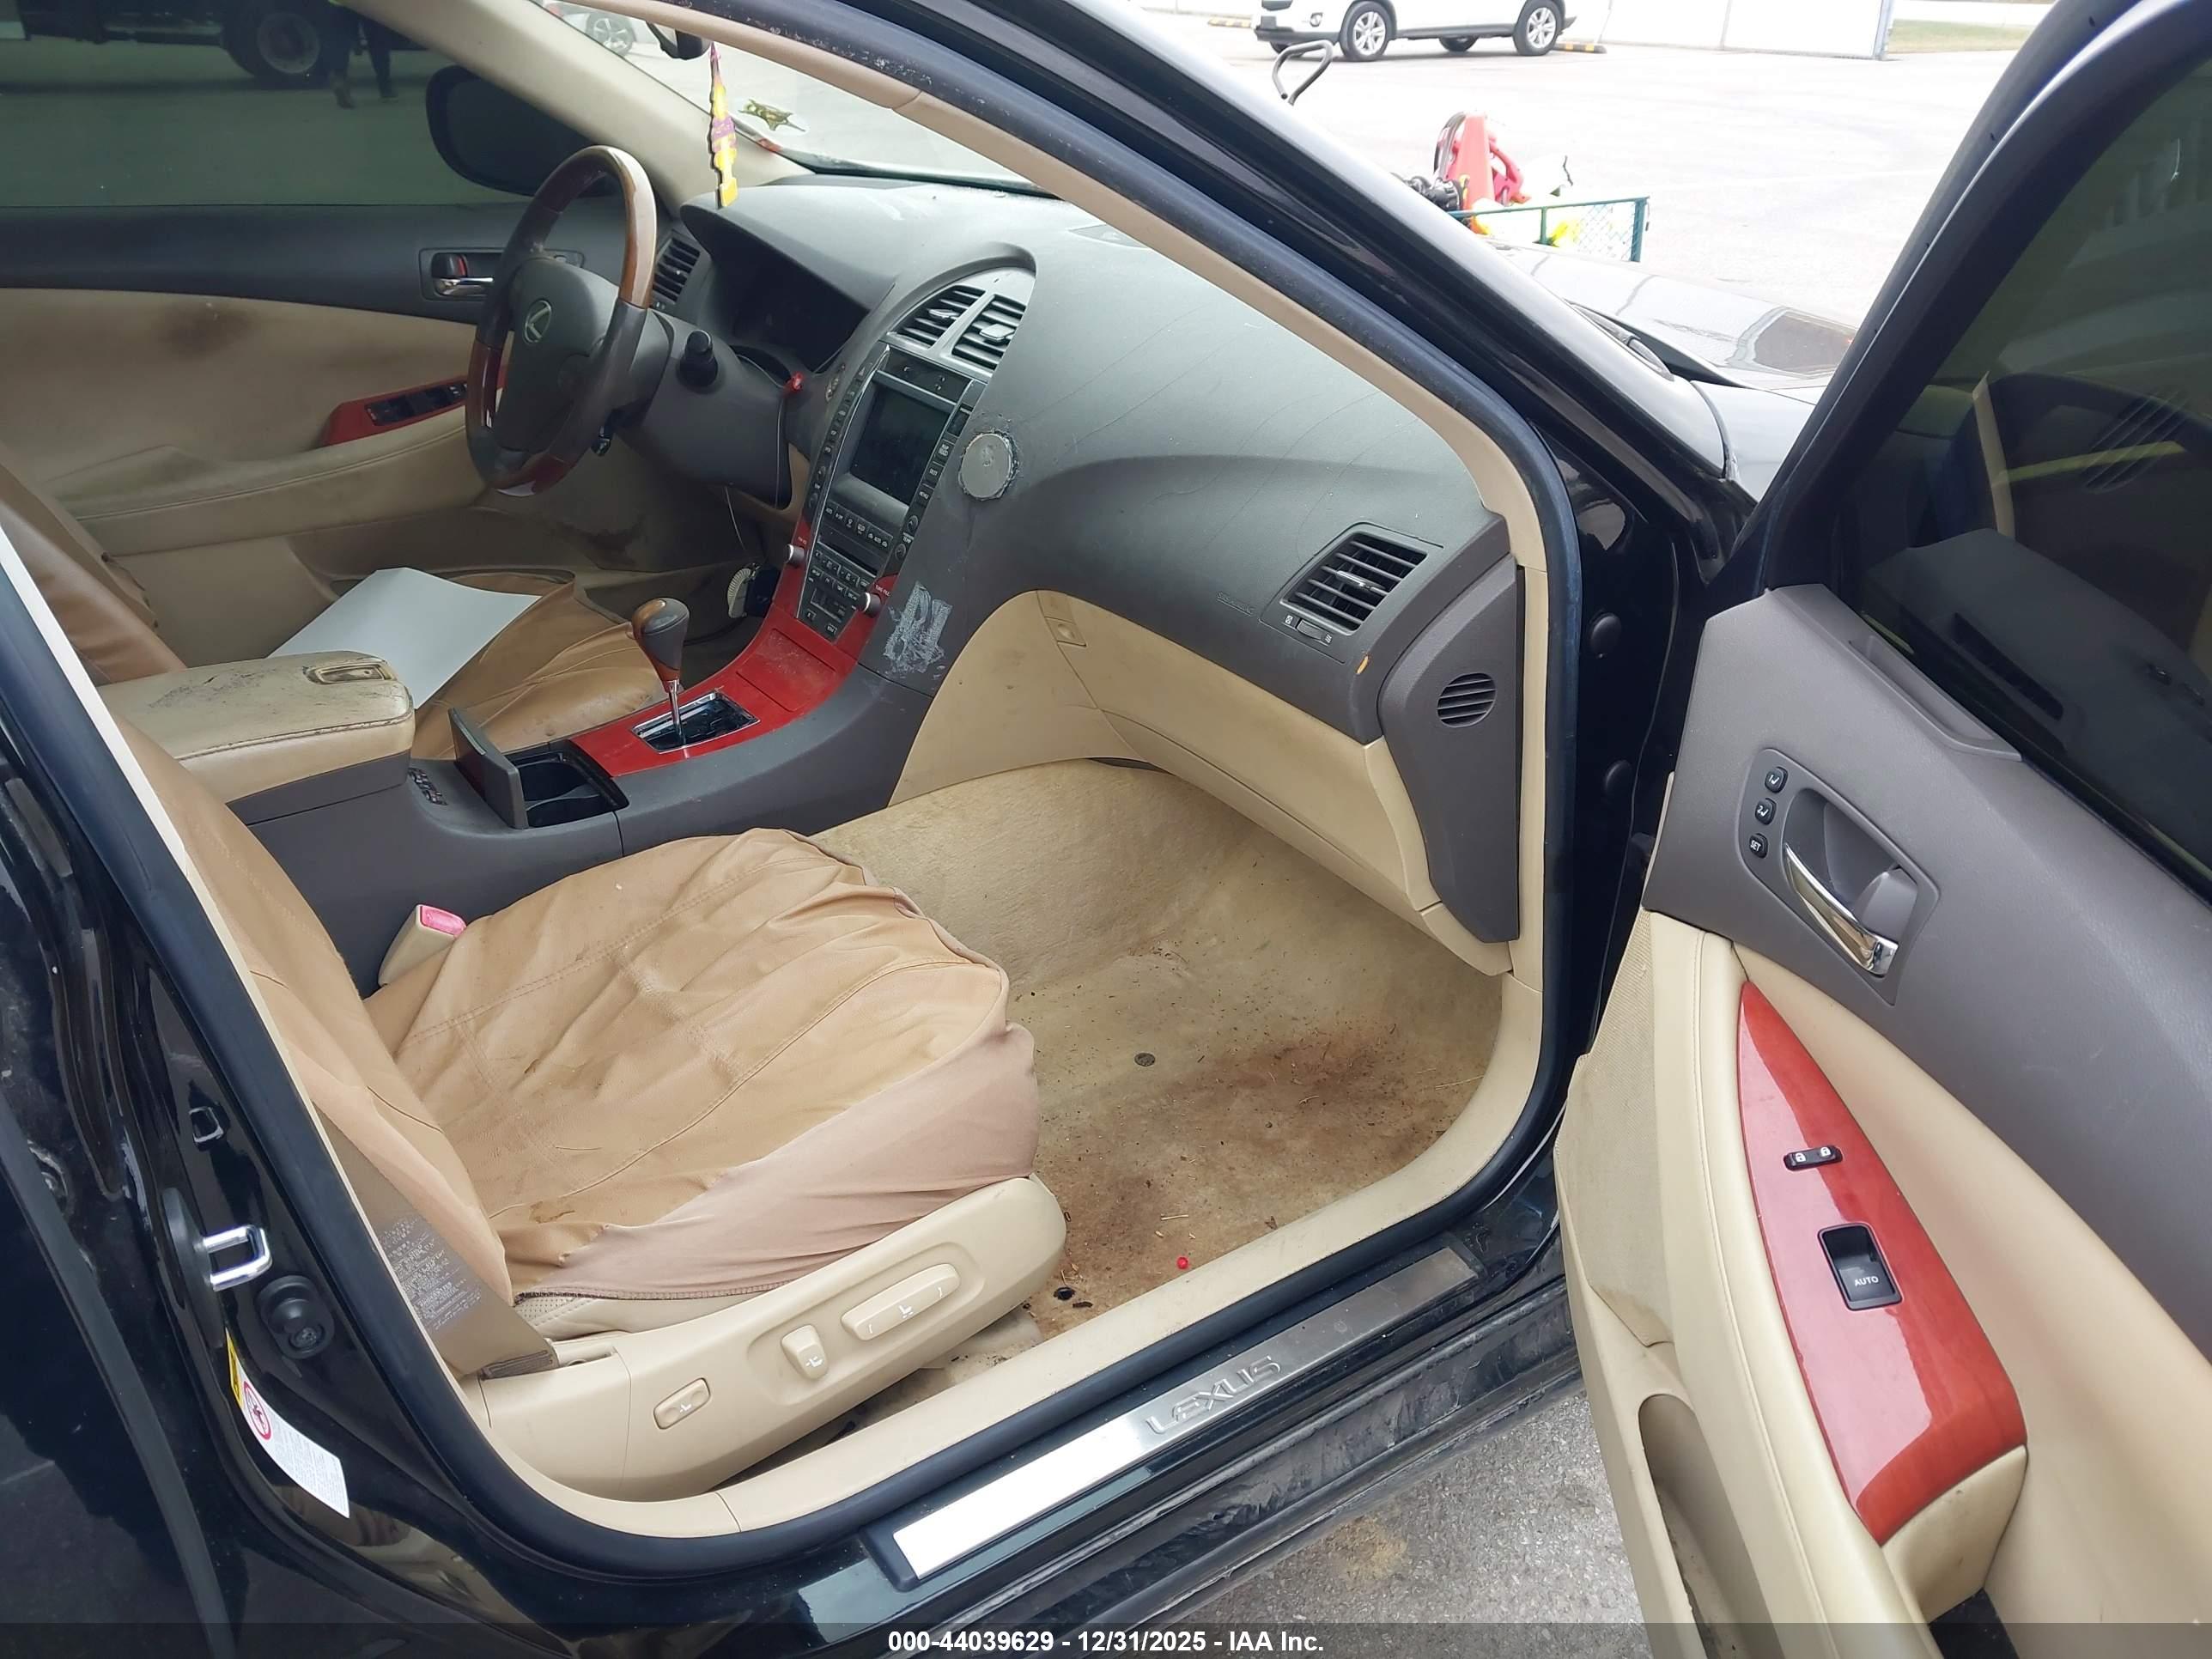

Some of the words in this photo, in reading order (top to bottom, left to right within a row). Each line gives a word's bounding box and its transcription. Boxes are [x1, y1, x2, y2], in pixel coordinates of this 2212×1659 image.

[1750, 840, 1762, 852] SET
[1854, 1276, 1879, 1287] AUTO
[1146, 1355, 1280, 1434] LEXUS
